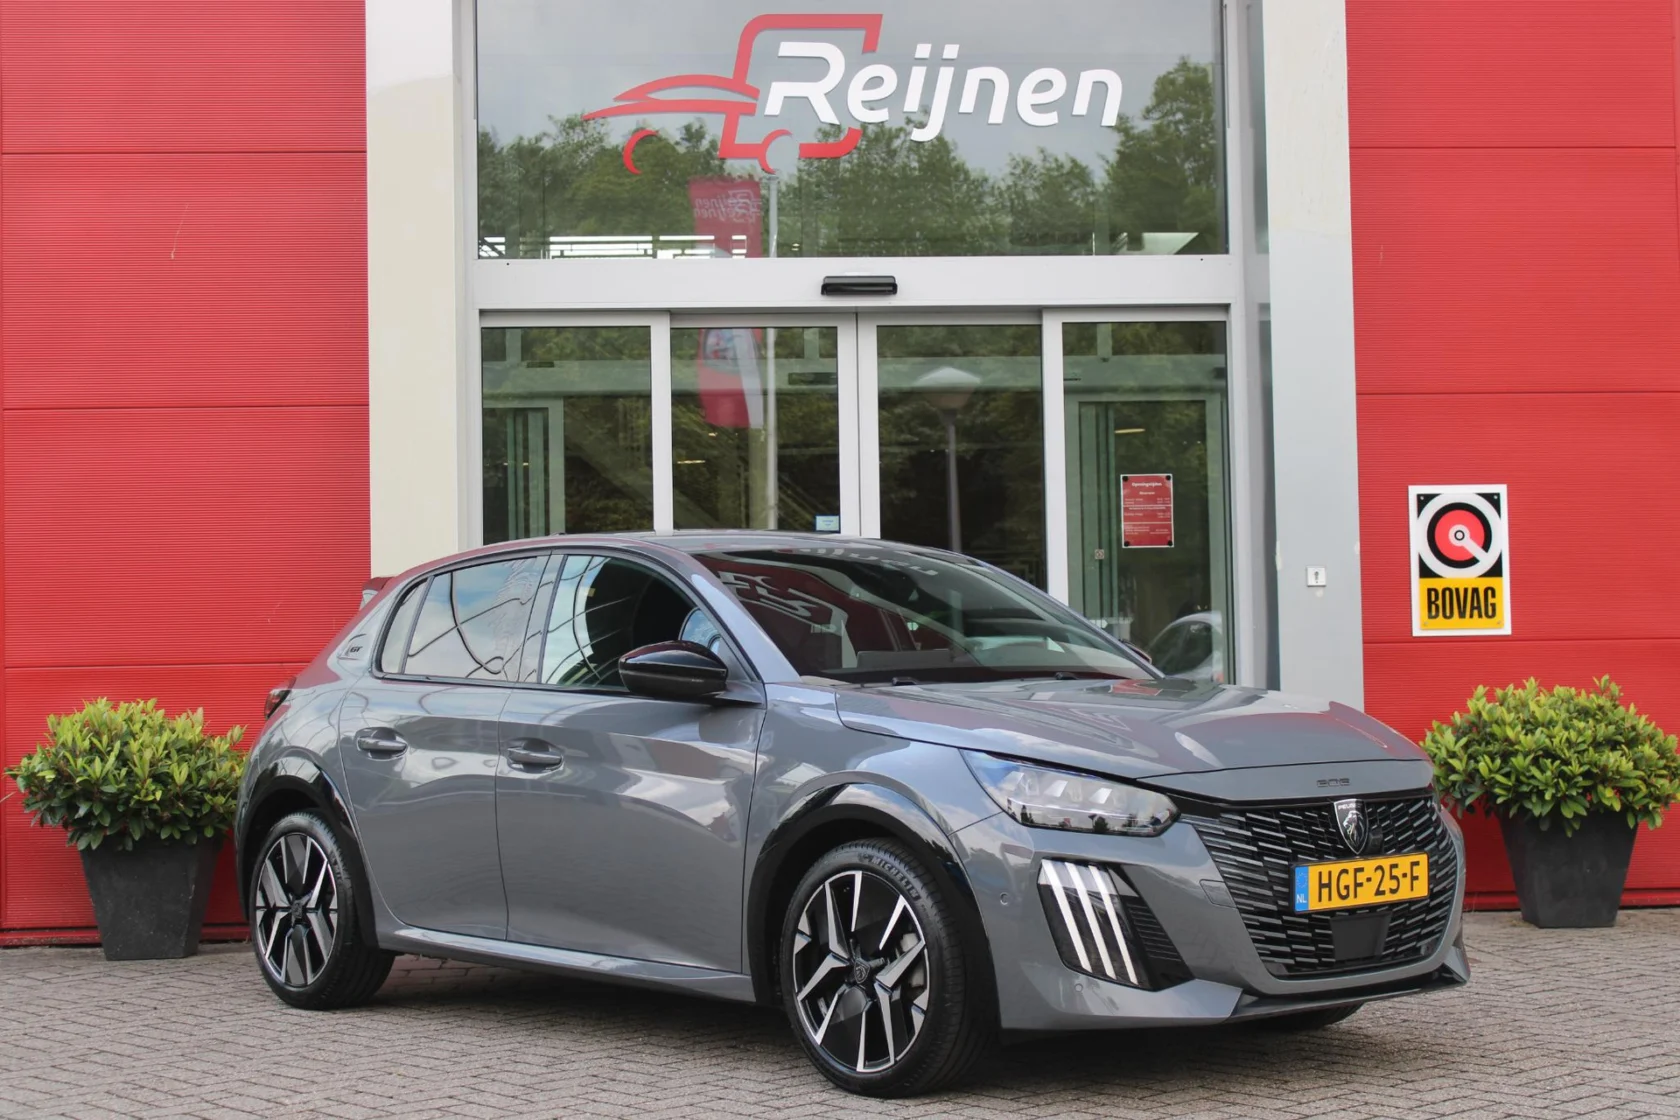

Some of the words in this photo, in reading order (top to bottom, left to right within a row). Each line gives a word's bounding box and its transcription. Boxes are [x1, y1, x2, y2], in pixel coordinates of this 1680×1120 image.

[764, 41, 1123, 142] Reijnen
[1427, 586, 1497, 620] BOVAG
[872, 856, 920, 898] MICHELIN
[1318, 861, 1420, 902] HGF-25-F
[1296, 894, 1307, 904] NL
